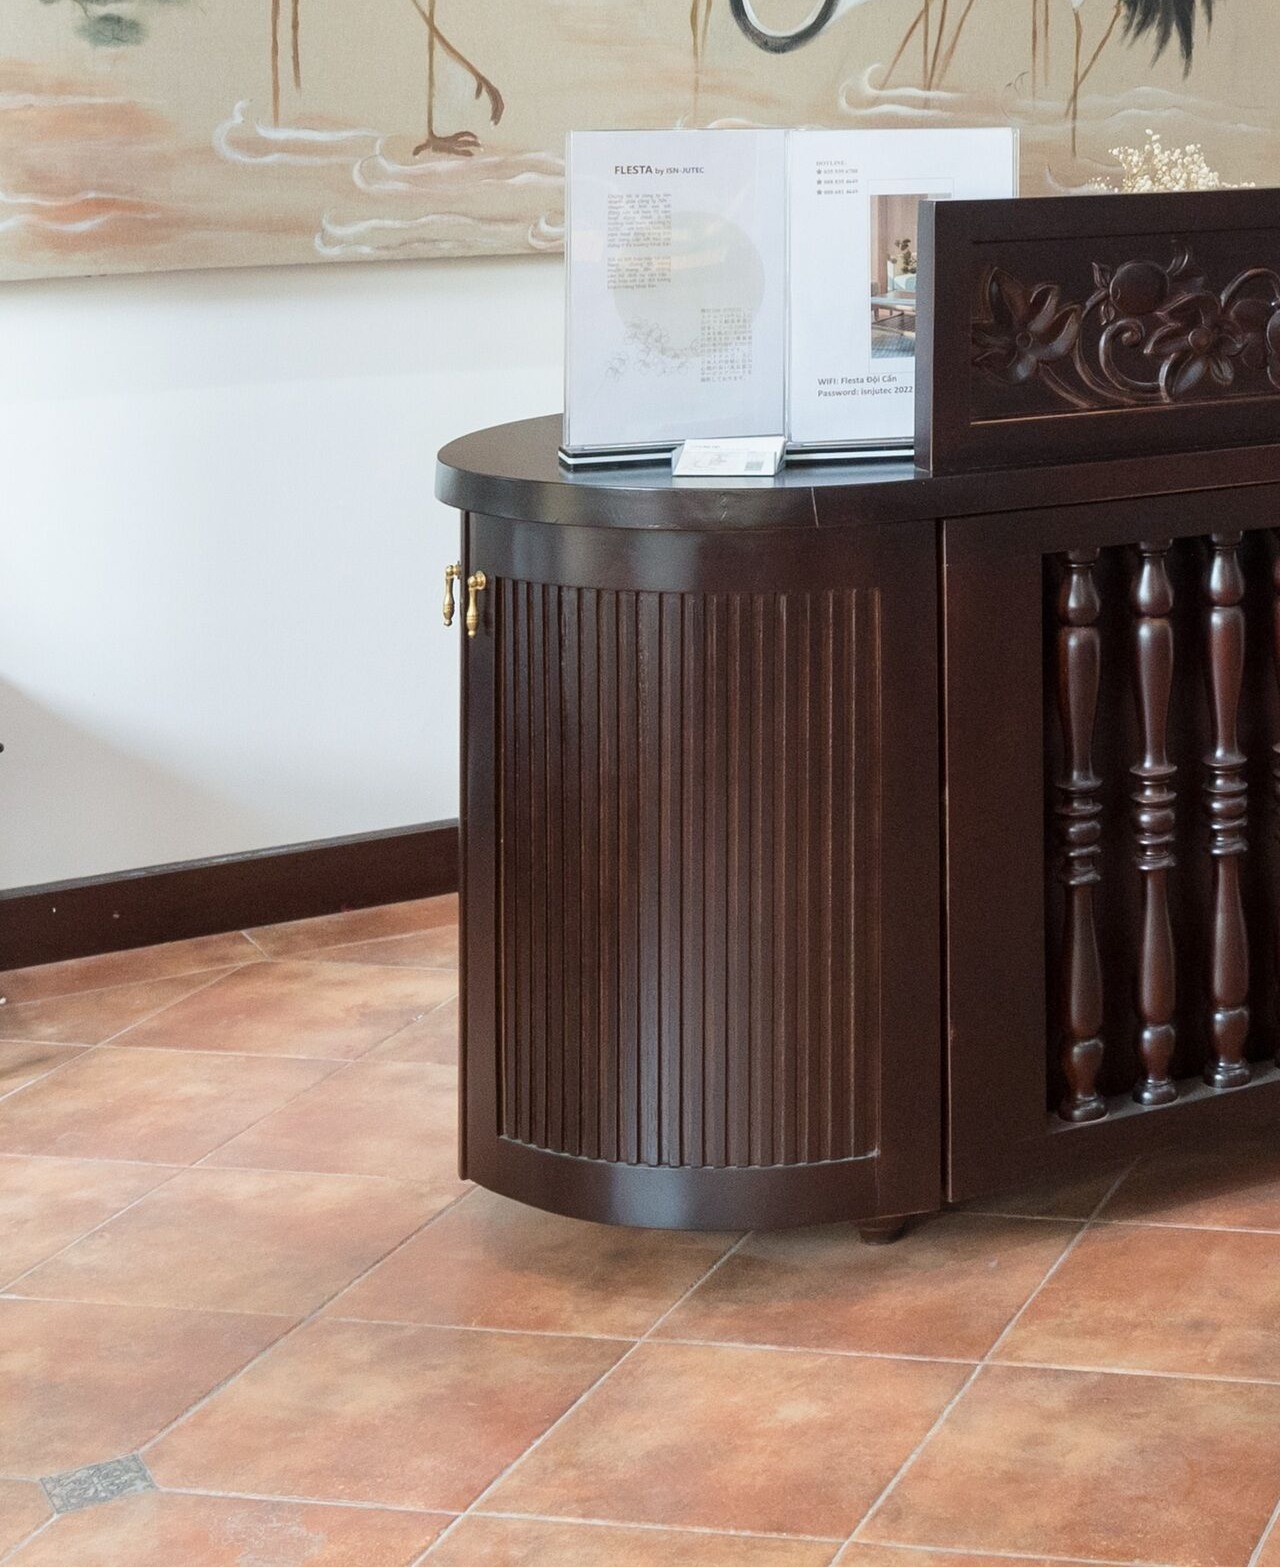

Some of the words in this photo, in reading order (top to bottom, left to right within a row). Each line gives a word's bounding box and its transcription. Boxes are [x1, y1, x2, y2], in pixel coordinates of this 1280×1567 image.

[614, 165, 653, 175] FLESTA
[655, 167, 665, 176] by
[840, 377, 864, 385] Flesta
[817, 388, 860, 397] Password:
[860, 387, 892, 396] isnjutec
[894, 386, 913, 394] 2022
